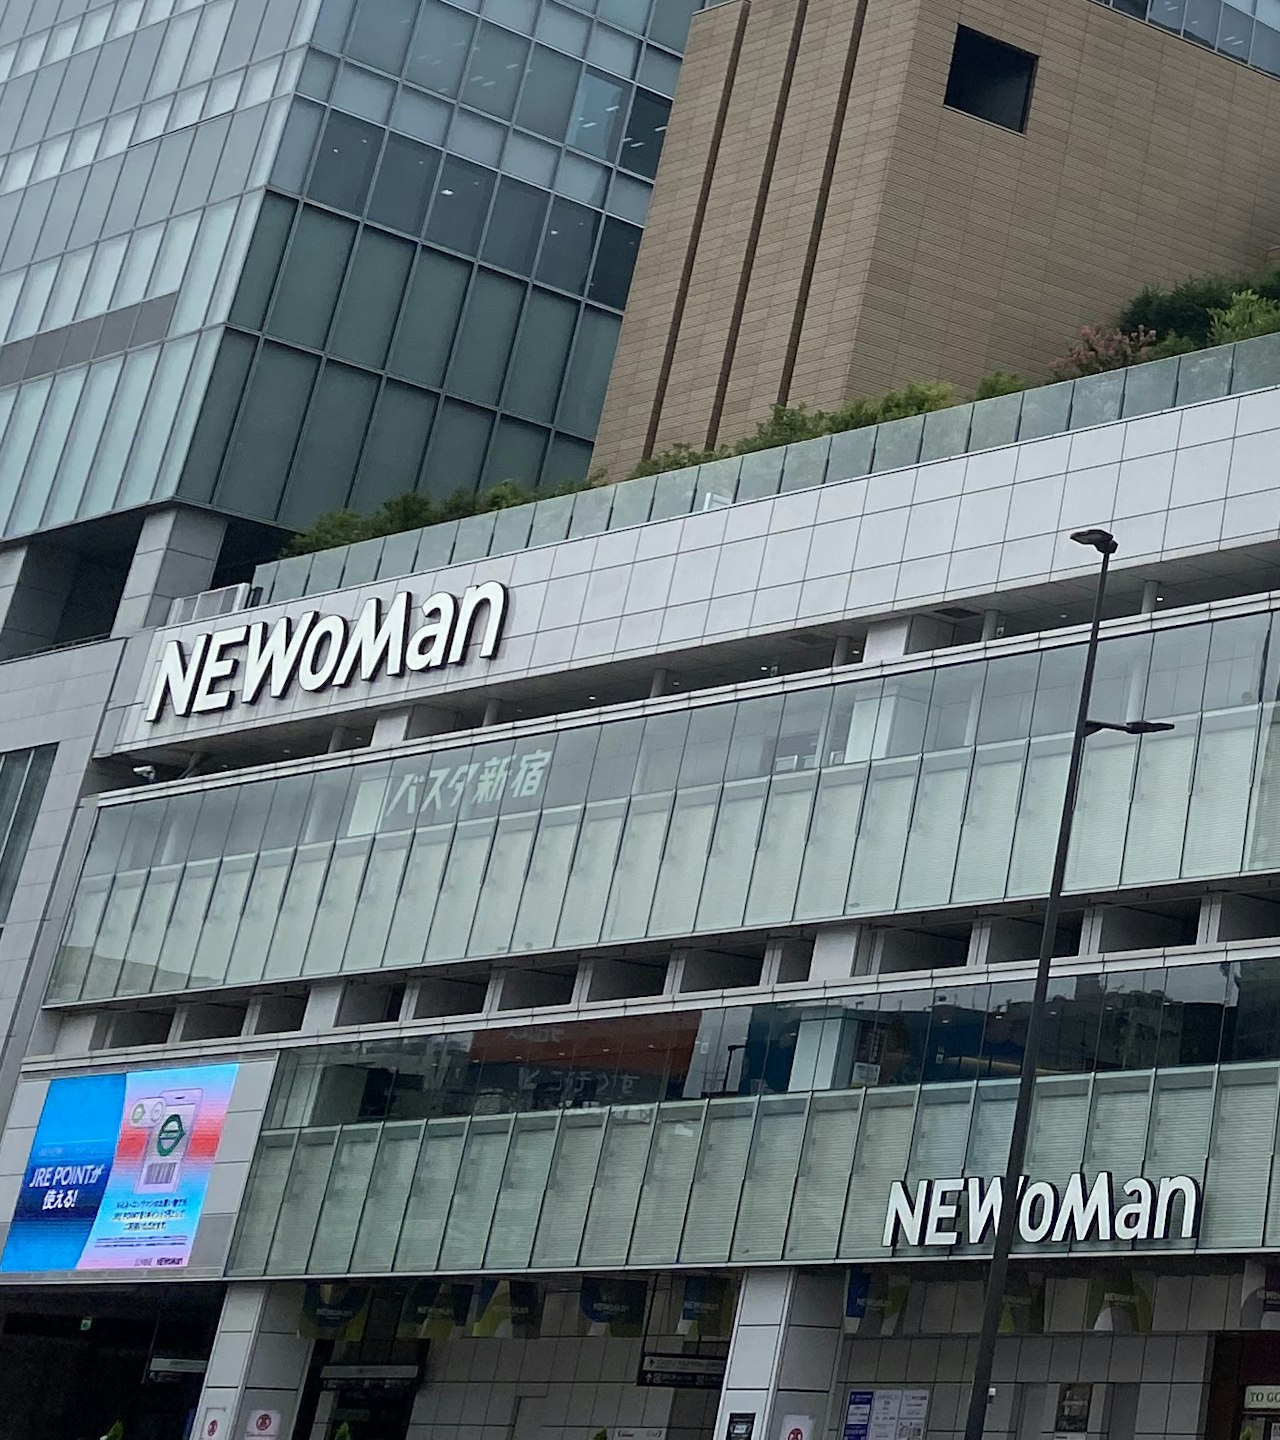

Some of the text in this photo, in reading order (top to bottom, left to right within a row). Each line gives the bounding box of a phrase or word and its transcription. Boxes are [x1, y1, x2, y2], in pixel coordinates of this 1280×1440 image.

[145, 580, 506, 722] NEWoMan
[386, 749, 553, 817] バスタ新宿
[29, 1168, 51, 1188] JRE
[1249, 1392, 1264, 1403] TO
